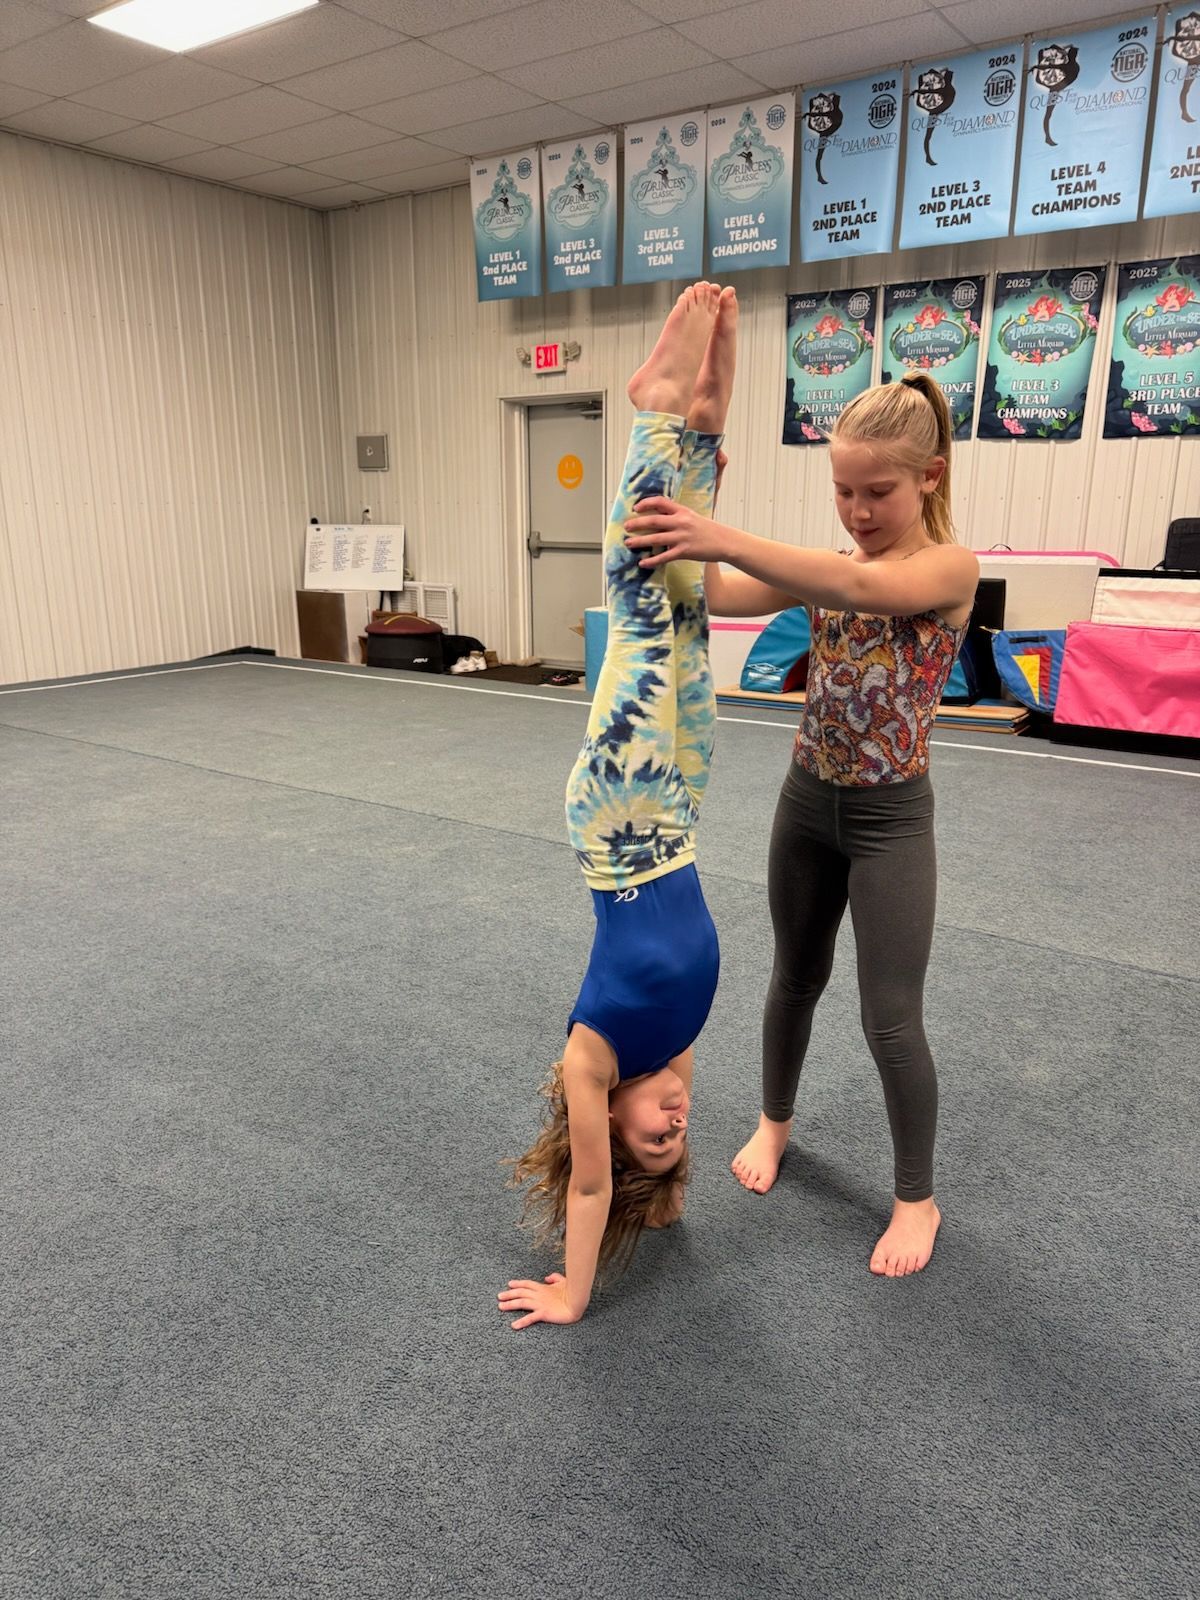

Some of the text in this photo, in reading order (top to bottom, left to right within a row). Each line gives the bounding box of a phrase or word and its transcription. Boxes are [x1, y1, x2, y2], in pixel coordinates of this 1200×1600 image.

[1118, 26, 1148, 43] 2024
[988, 54, 1016, 69] 2024
[1114, 53, 1145, 72] NGA
[871, 79, 896, 94] 2024
[987, 79, 1013, 97] NGA
[1029, 88, 1073, 111] QUST
[1074, 86, 1147, 110] DIAMOND
[871, 103, 894, 120] NGA
[911, 112, 951, 132] QUST
[952, 110, 1016, 132] DIAMOND
[804, 134, 840, 153] QUST
[841, 132, 898, 153] DIAMOND
[718, 158, 772, 186] PRINCESS
[734, 172, 760, 183] CLASSIC
[1050, 161, 1106, 182] LEVEL 4
[637, 176, 686, 202] PRINCESS
[651, 189, 675, 200] CLASSIC
[931, 180, 981, 199] LEVEL 3
[1056, 180, 1097, 196] TEAM
[554, 190, 600, 213] PRINCESS
[569, 203, 590, 212] CLASSIC
[823, 198, 867, 216] LEVEL 1
[919, 194, 991, 216] 2ND PLACE
[1031, 193, 1121, 216] CHAMPIONS
[483, 204, 525, 227] PRINCESS
[724, 212, 765, 229] LEVEL 6
[812, 211, 877, 232] 2ND PLACE
[935, 212, 972, 229] TEAM
[644, 227, 679, 242] LEVEL 5
[729, 227, 759, 242] TEAM
[827, 228, 860, 243] TEAM
[560, 238, 596, 253] LEVEL 3
[637, 240, 685, 255] 3rd PLACE
[712, 239, 778, 258] CHAMPIONS
[489, 250, 520, 263] LEVEL 1
[553, 250, 602, 266] 2nd PLACE
[648, 254, 674, 267] TEAM
[483, 261, 528, 276] 2nd PLACE
[564, 264, 590, 277] TEAM
[1129, 267, 1158, 280] 2025
[493, 275, 517, 286] TEAM
[1006, 278, 1031, 289] 2025
[1072, 280, 1095, 293] NGA
[893, 288, 917, 299] 2025
[954, 288, 976, 301] NGA
[795, 299, 817, 309] 2025
[1137, 313, 1176, 334] UNDER
[1187, 312, 1200, 325] SE
[1010, 323, 1045, 340] UNDER
[1055, 322, 1076, 339] SEA
[1144, 327, 1198, 342] LITTLE MERMAID
[802, 339, 830, 355] UNDER
[838, 338, 857, 352] SEA
[899, 331, 932, 348] UNDER
[940, 330, 961, 344] SEA
[1017, 337, 1064, 349] LITTLE MERMAID
[536, 344, 559, 369] EXIT
[907, 347, 924, 356] LITTLE
[938, 381, 974, 393] RONZE
[1011, 380, 1060, 391] LEVEL 3
[1140, 372, 1193, 387] LEVEL 5
[807, 389, 845, 401] LEVEL 1
[1018, 393, 1050, 405] TEAM
[1128, 390, 1156, 402] 3RD
[799, 402, 848, 414] 2ND PLAC
[997, 407, 1067, 420] CHAMPIONS
[1146, 402, 1181, 416] TEAM
